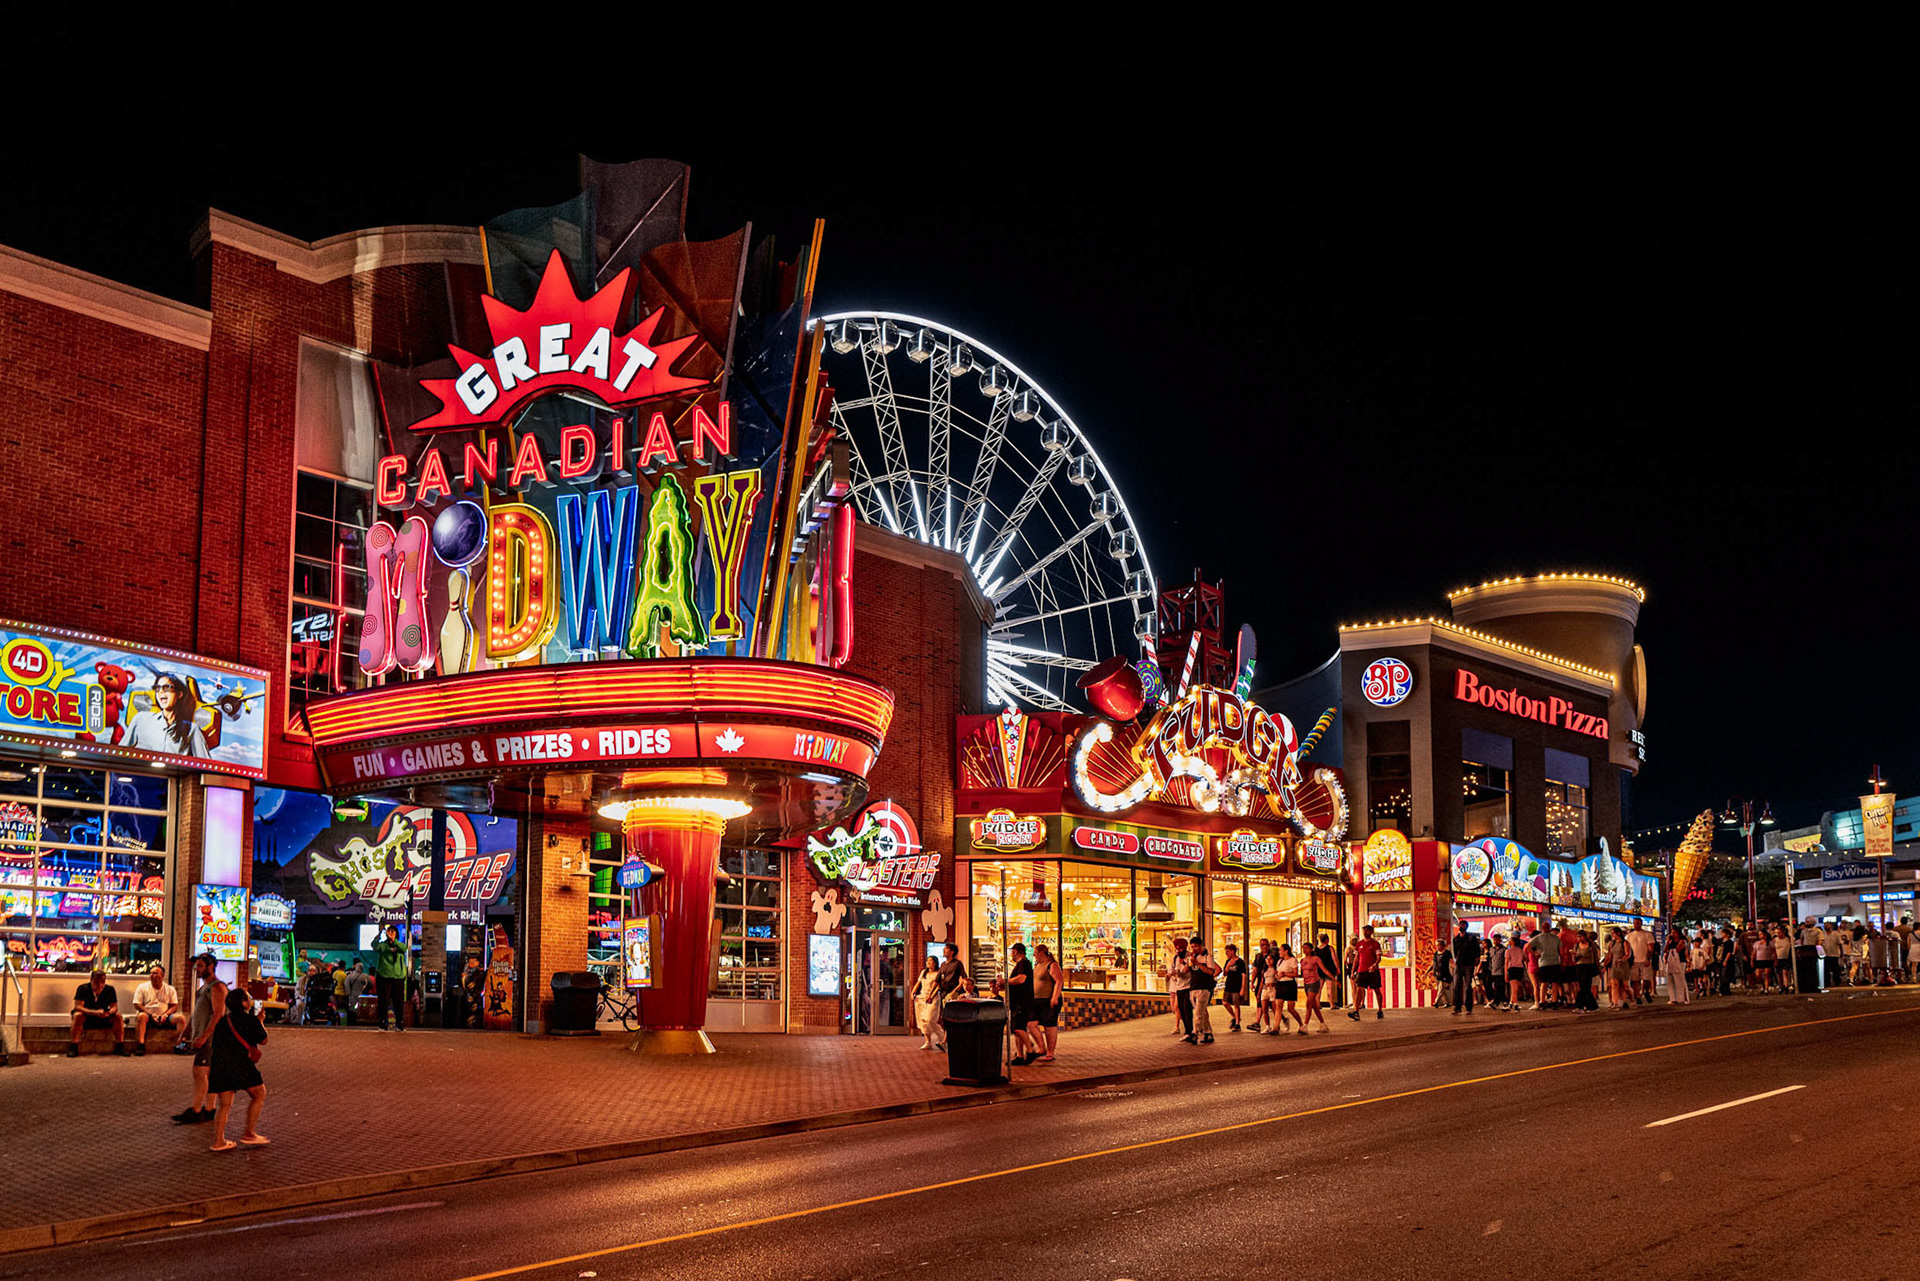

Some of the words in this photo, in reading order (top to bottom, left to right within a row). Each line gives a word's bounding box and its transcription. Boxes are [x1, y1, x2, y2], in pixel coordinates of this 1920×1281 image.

[454, 322, 658, 416] GREAT
[377, 401, 731, 506] CANADIAN
[0, 638, 76, 691] OY
[12, 649, 43, 673] 4D
[1365, 664, 1410, 704] BP
[91, 690, 102, 728] RIDE
[353, 756, 385, 779] FUN
[401, 744, 465, 773] GAMES
[471, 743, 489, 764] &
[498, 734, 573, 762] PRIZES
[598, 728, 671, 756] RIDES
[1146, 688, 1303, 811] FUDGE
[981, 820, 1038, 836] FUDGE
[1872, 815, 1888, 828] Hill
[1090, 832, 1126, 850] CANDY
[1147, 839, 1202, 858] CHOCOLATE
[1227, 841, 1279, 854] FUDGE
[813, 824, 881, 881] GHOST
[1306, 845, 1340, 860] FUDGE
[312, 828, 414, 901] GHOST
[846, 854, 941, 890] BLASTERS
[1365, 865, 1411, 886] POPCORN
[1824, 866, 1880, 879] SkyWhee
[861, 892, 892, 903] Interactive
[892, 895, 907, 905] Dark
[908, 897, 921, 906] Ride
[1491, 899, 1509, 907] POPCORN
[202, 932, 238, 944] STORE
